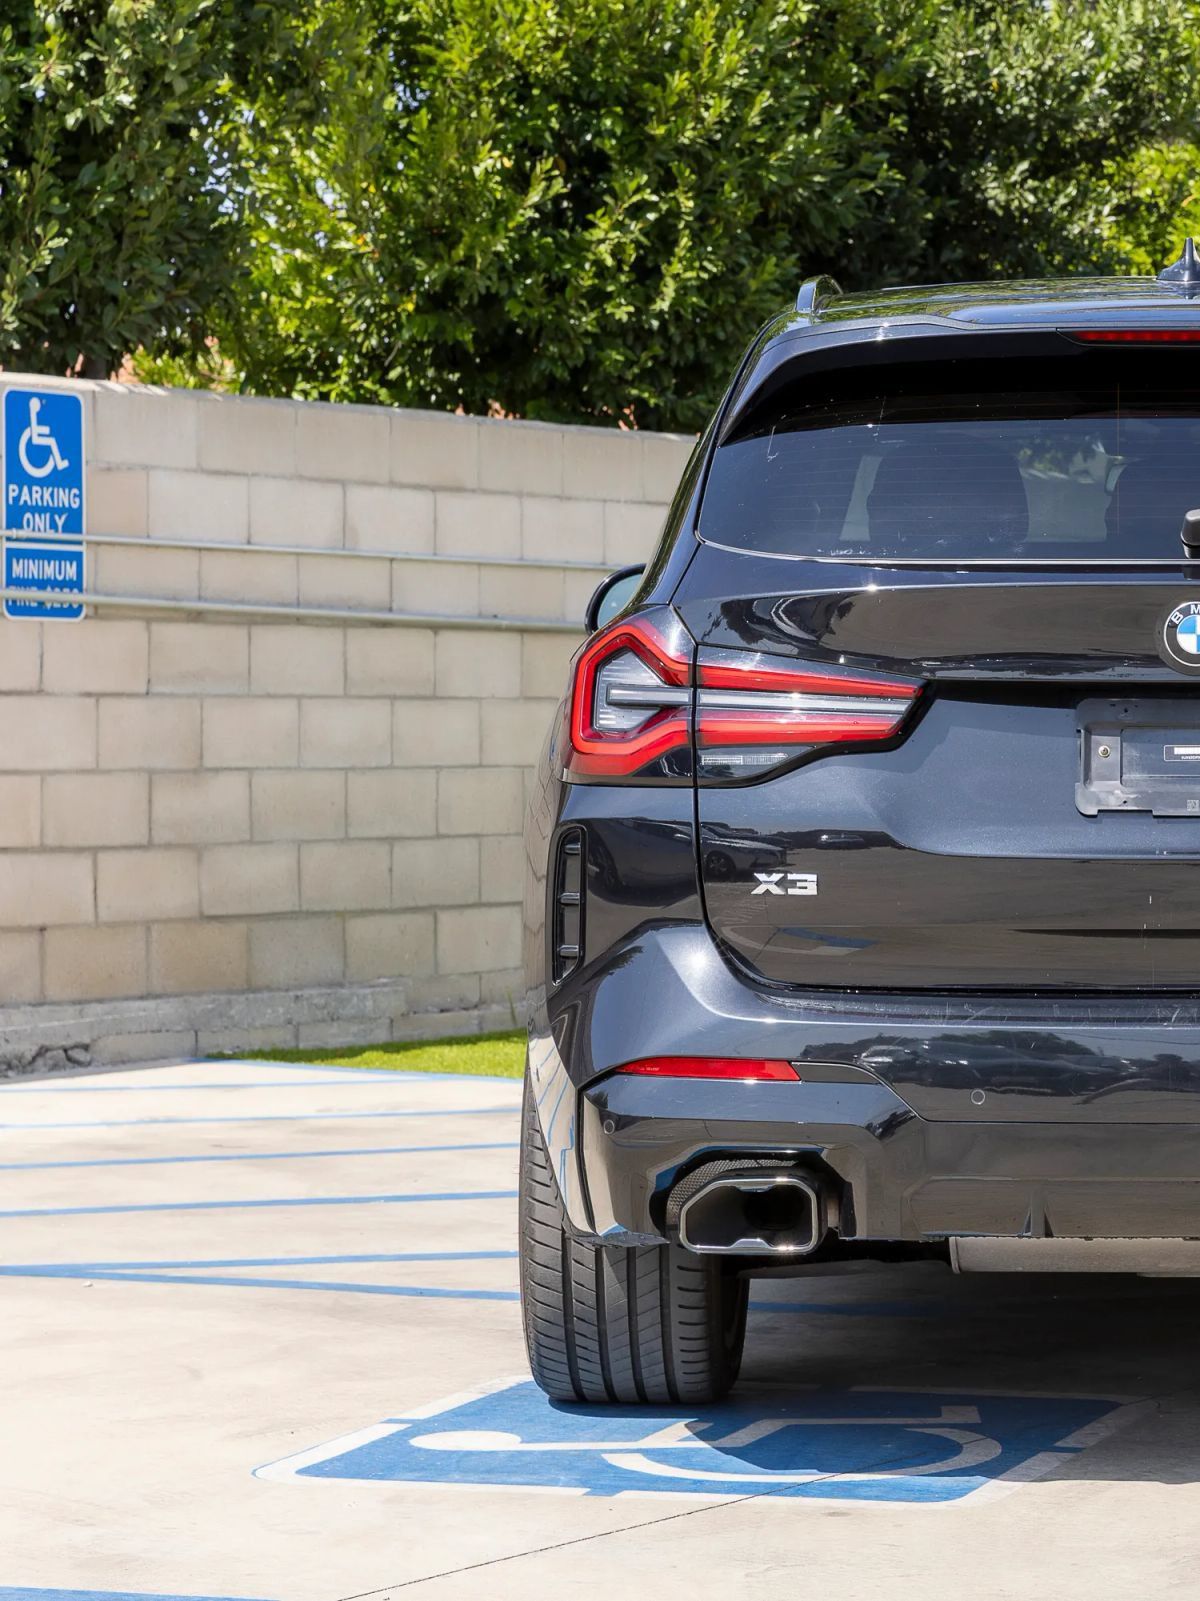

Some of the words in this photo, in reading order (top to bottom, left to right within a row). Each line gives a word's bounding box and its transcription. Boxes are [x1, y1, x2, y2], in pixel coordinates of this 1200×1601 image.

[8, 483, 80, 509] PARKING
[23, 511, 68, 535] ONLY
[12, 557, 77, 581] MINIMUM
[750, 872, 818, 896] X3
